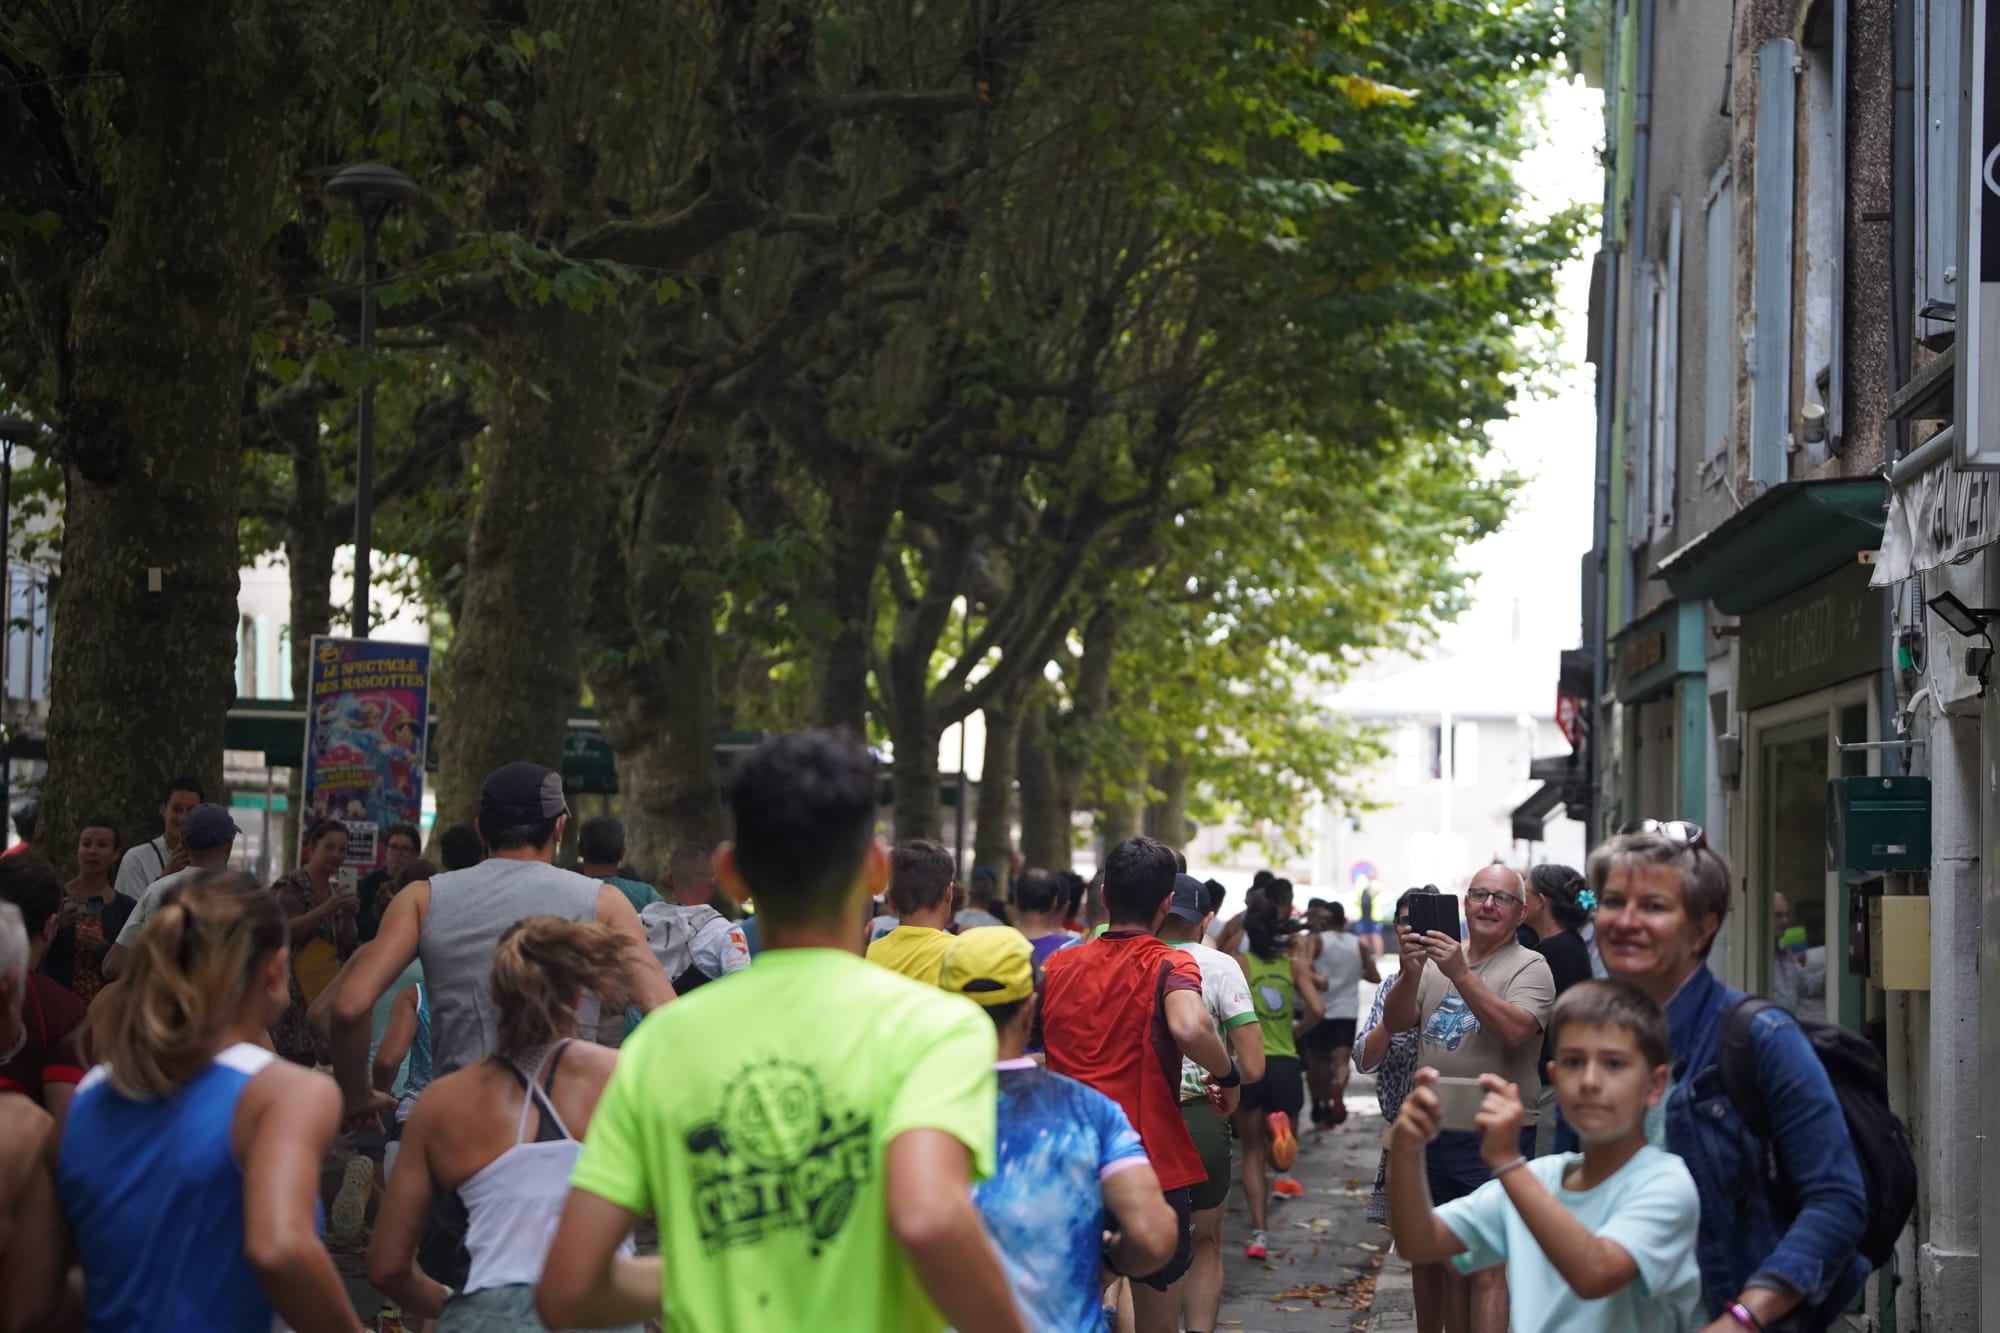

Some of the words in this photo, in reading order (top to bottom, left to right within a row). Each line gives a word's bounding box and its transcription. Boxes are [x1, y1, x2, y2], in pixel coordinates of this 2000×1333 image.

[323, 664, 338, 679] LE
[341, 658, 418, 676] SPECTACLE
[315, 681, 339, 695] DES
[342, 674, 425, 690] MASCOTTES
